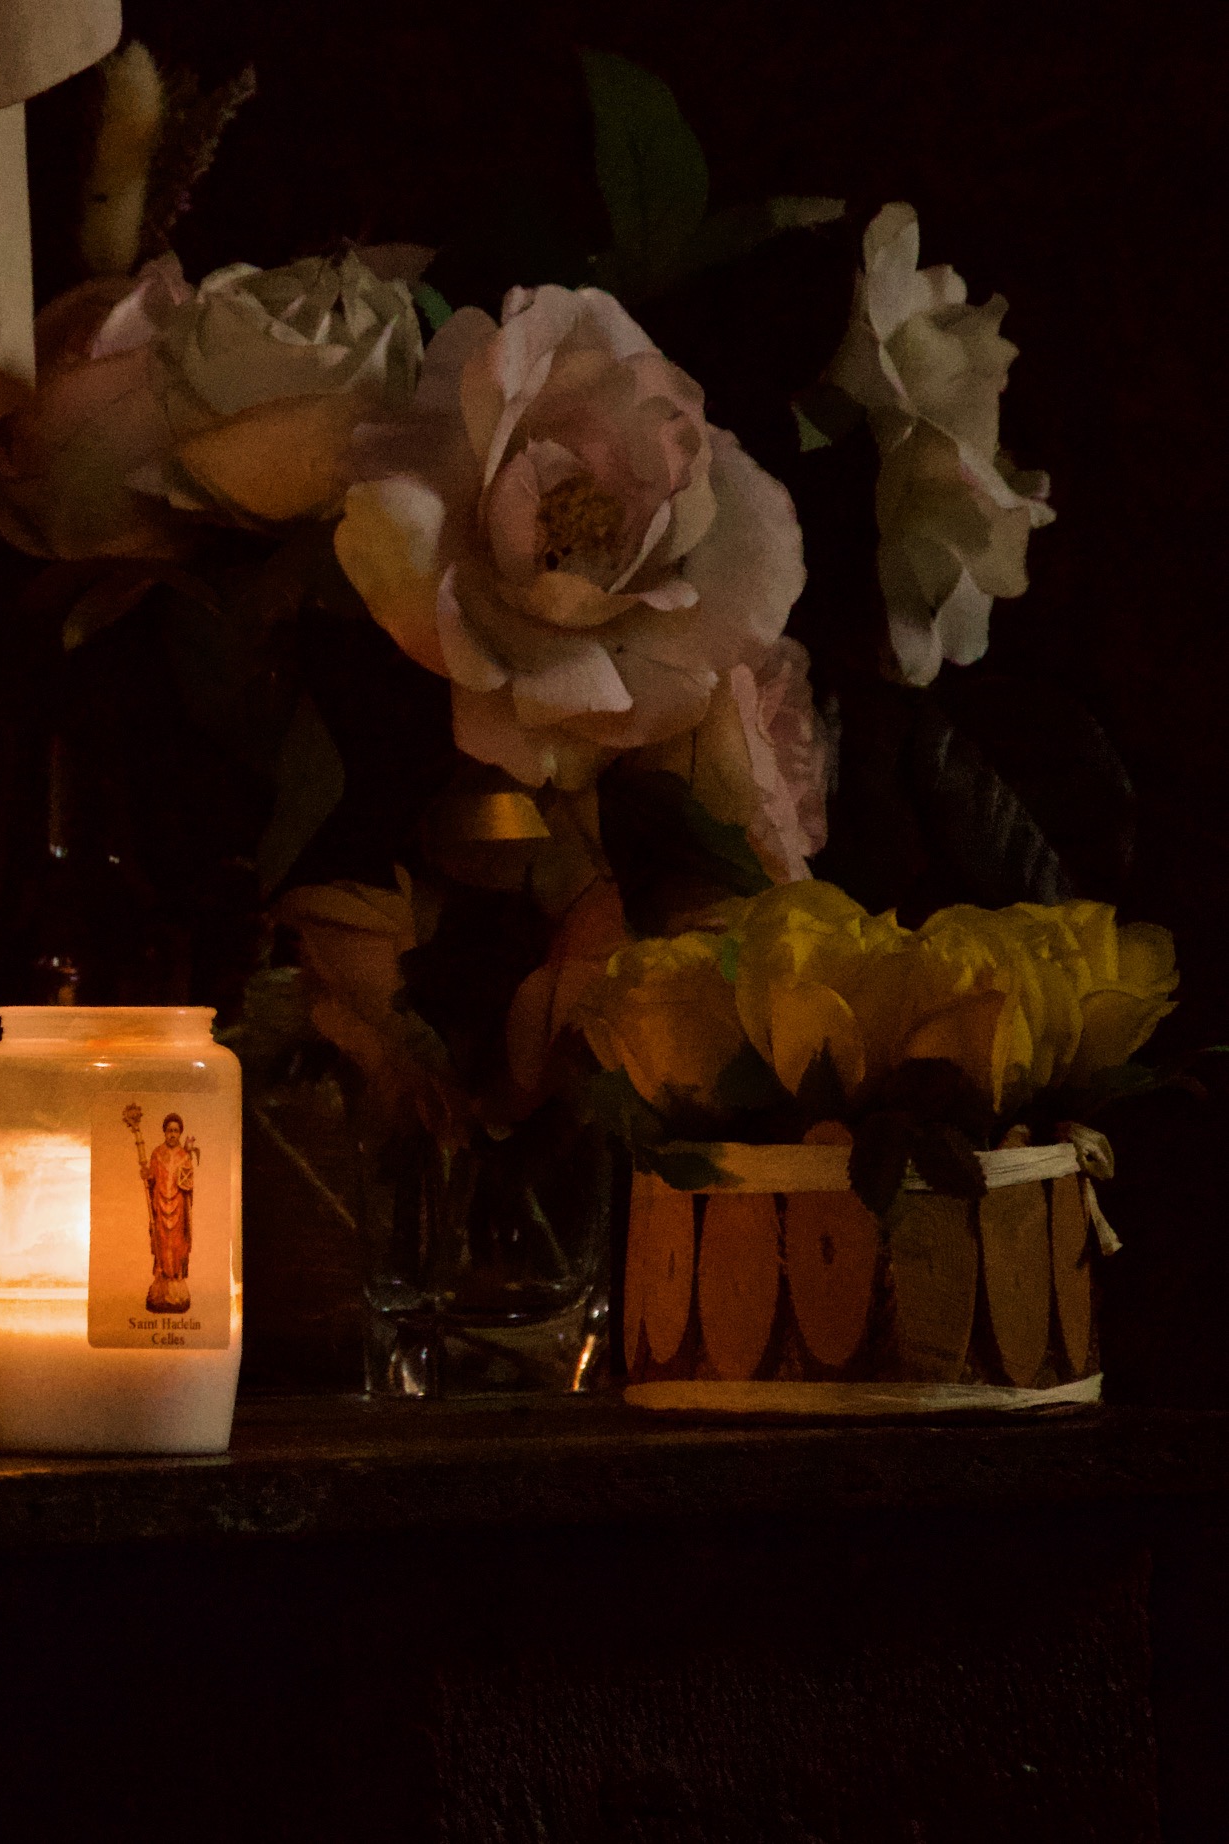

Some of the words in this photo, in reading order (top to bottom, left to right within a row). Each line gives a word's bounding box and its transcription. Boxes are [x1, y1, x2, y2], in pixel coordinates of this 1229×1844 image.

[128, 1317, 158, 1330] Saint
[162, 1317, 201, 1330] Hadelin
[151, 1332, 185, 1345] Celles
